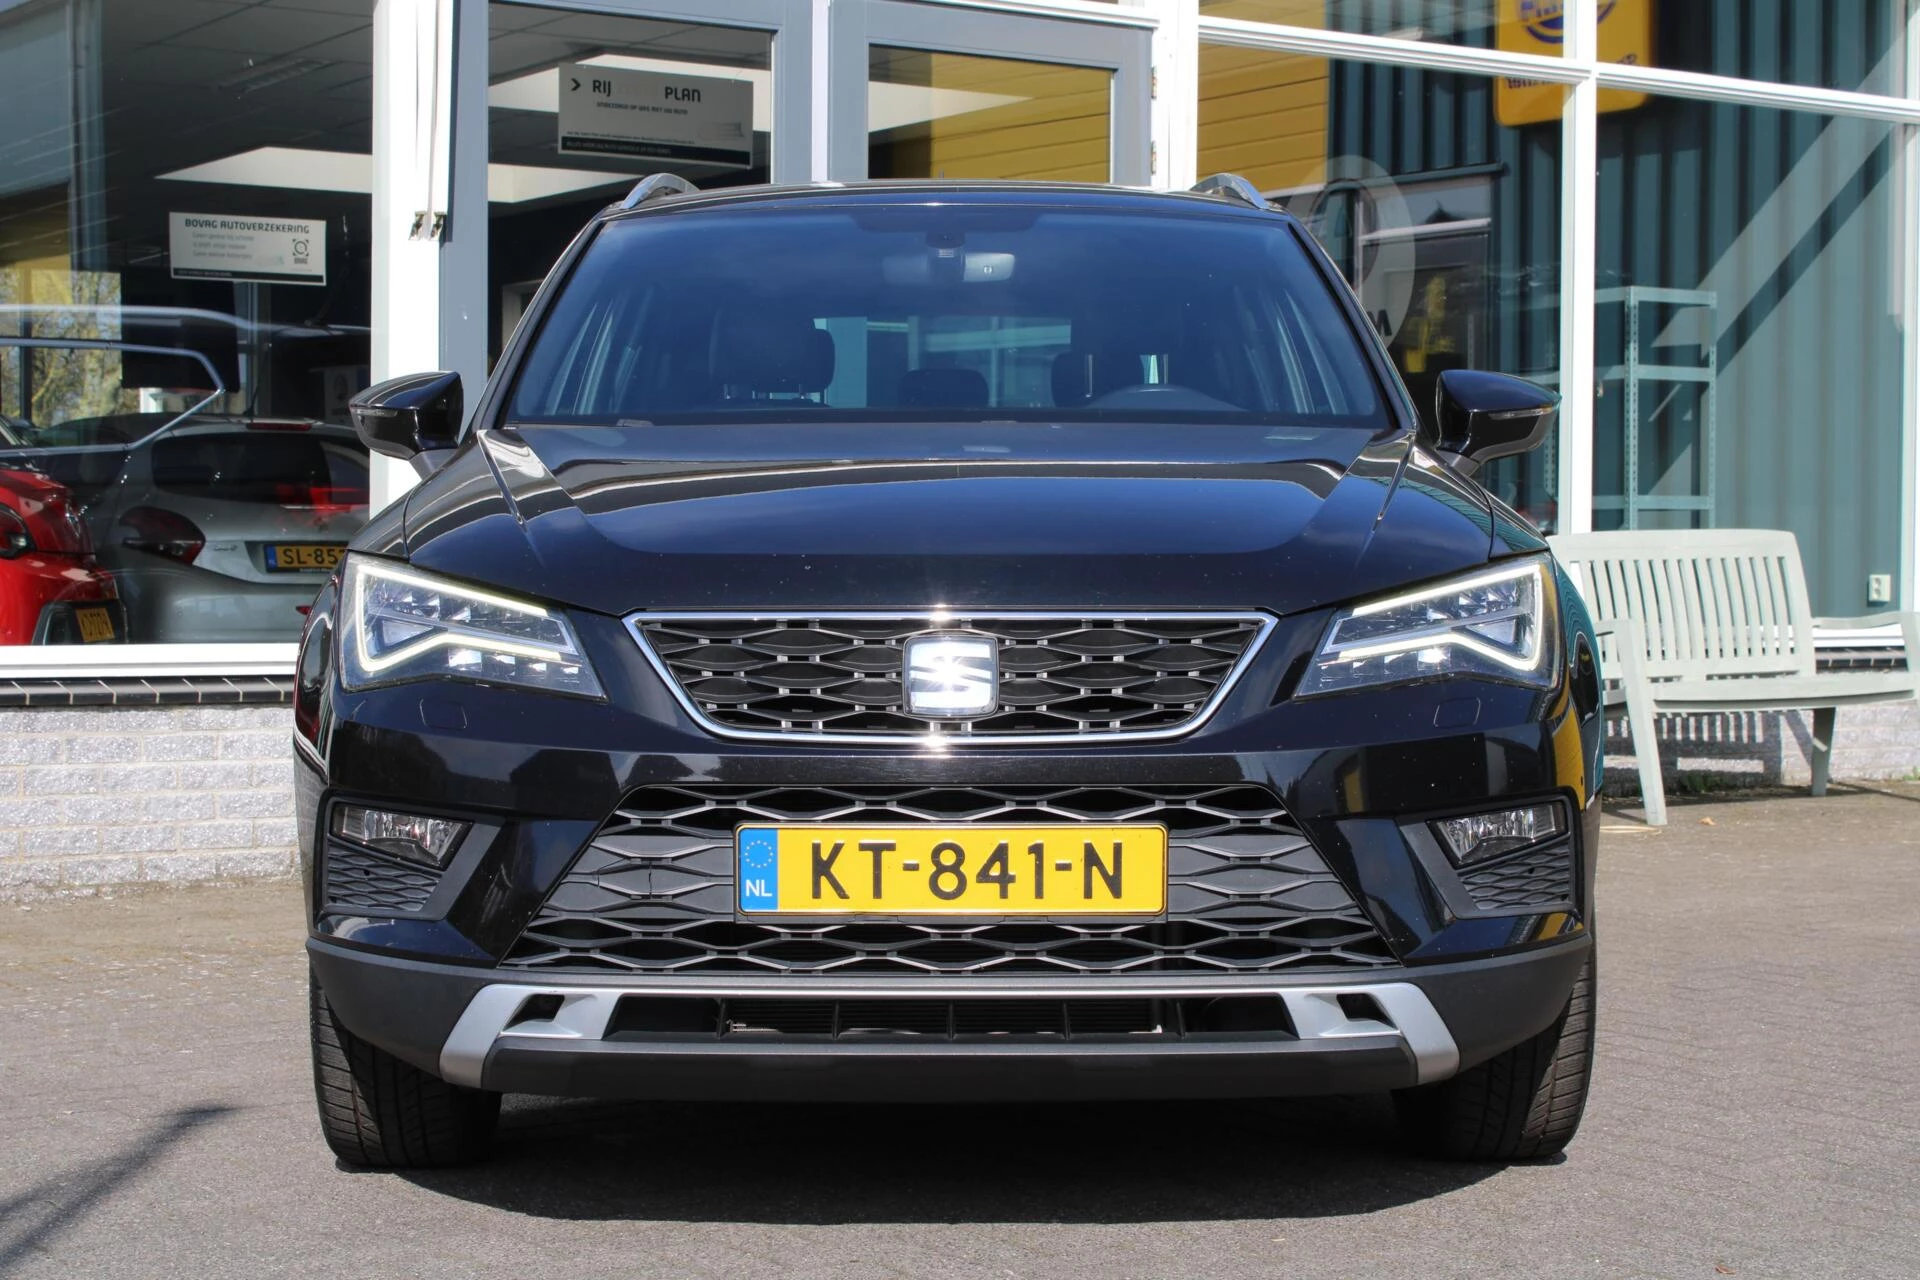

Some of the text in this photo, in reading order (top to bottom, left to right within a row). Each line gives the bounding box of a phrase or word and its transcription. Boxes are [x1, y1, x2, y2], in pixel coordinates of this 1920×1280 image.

[592, 79, 702, 103] RIJ PLAN
[184, 218, 310, 234] BOVAG AUTOVERZEKERING
[283, 548, 345, 565] SL-85
[811, 840, 1123, 900] KT-841-N
[745, 879, 772, 898] NL
